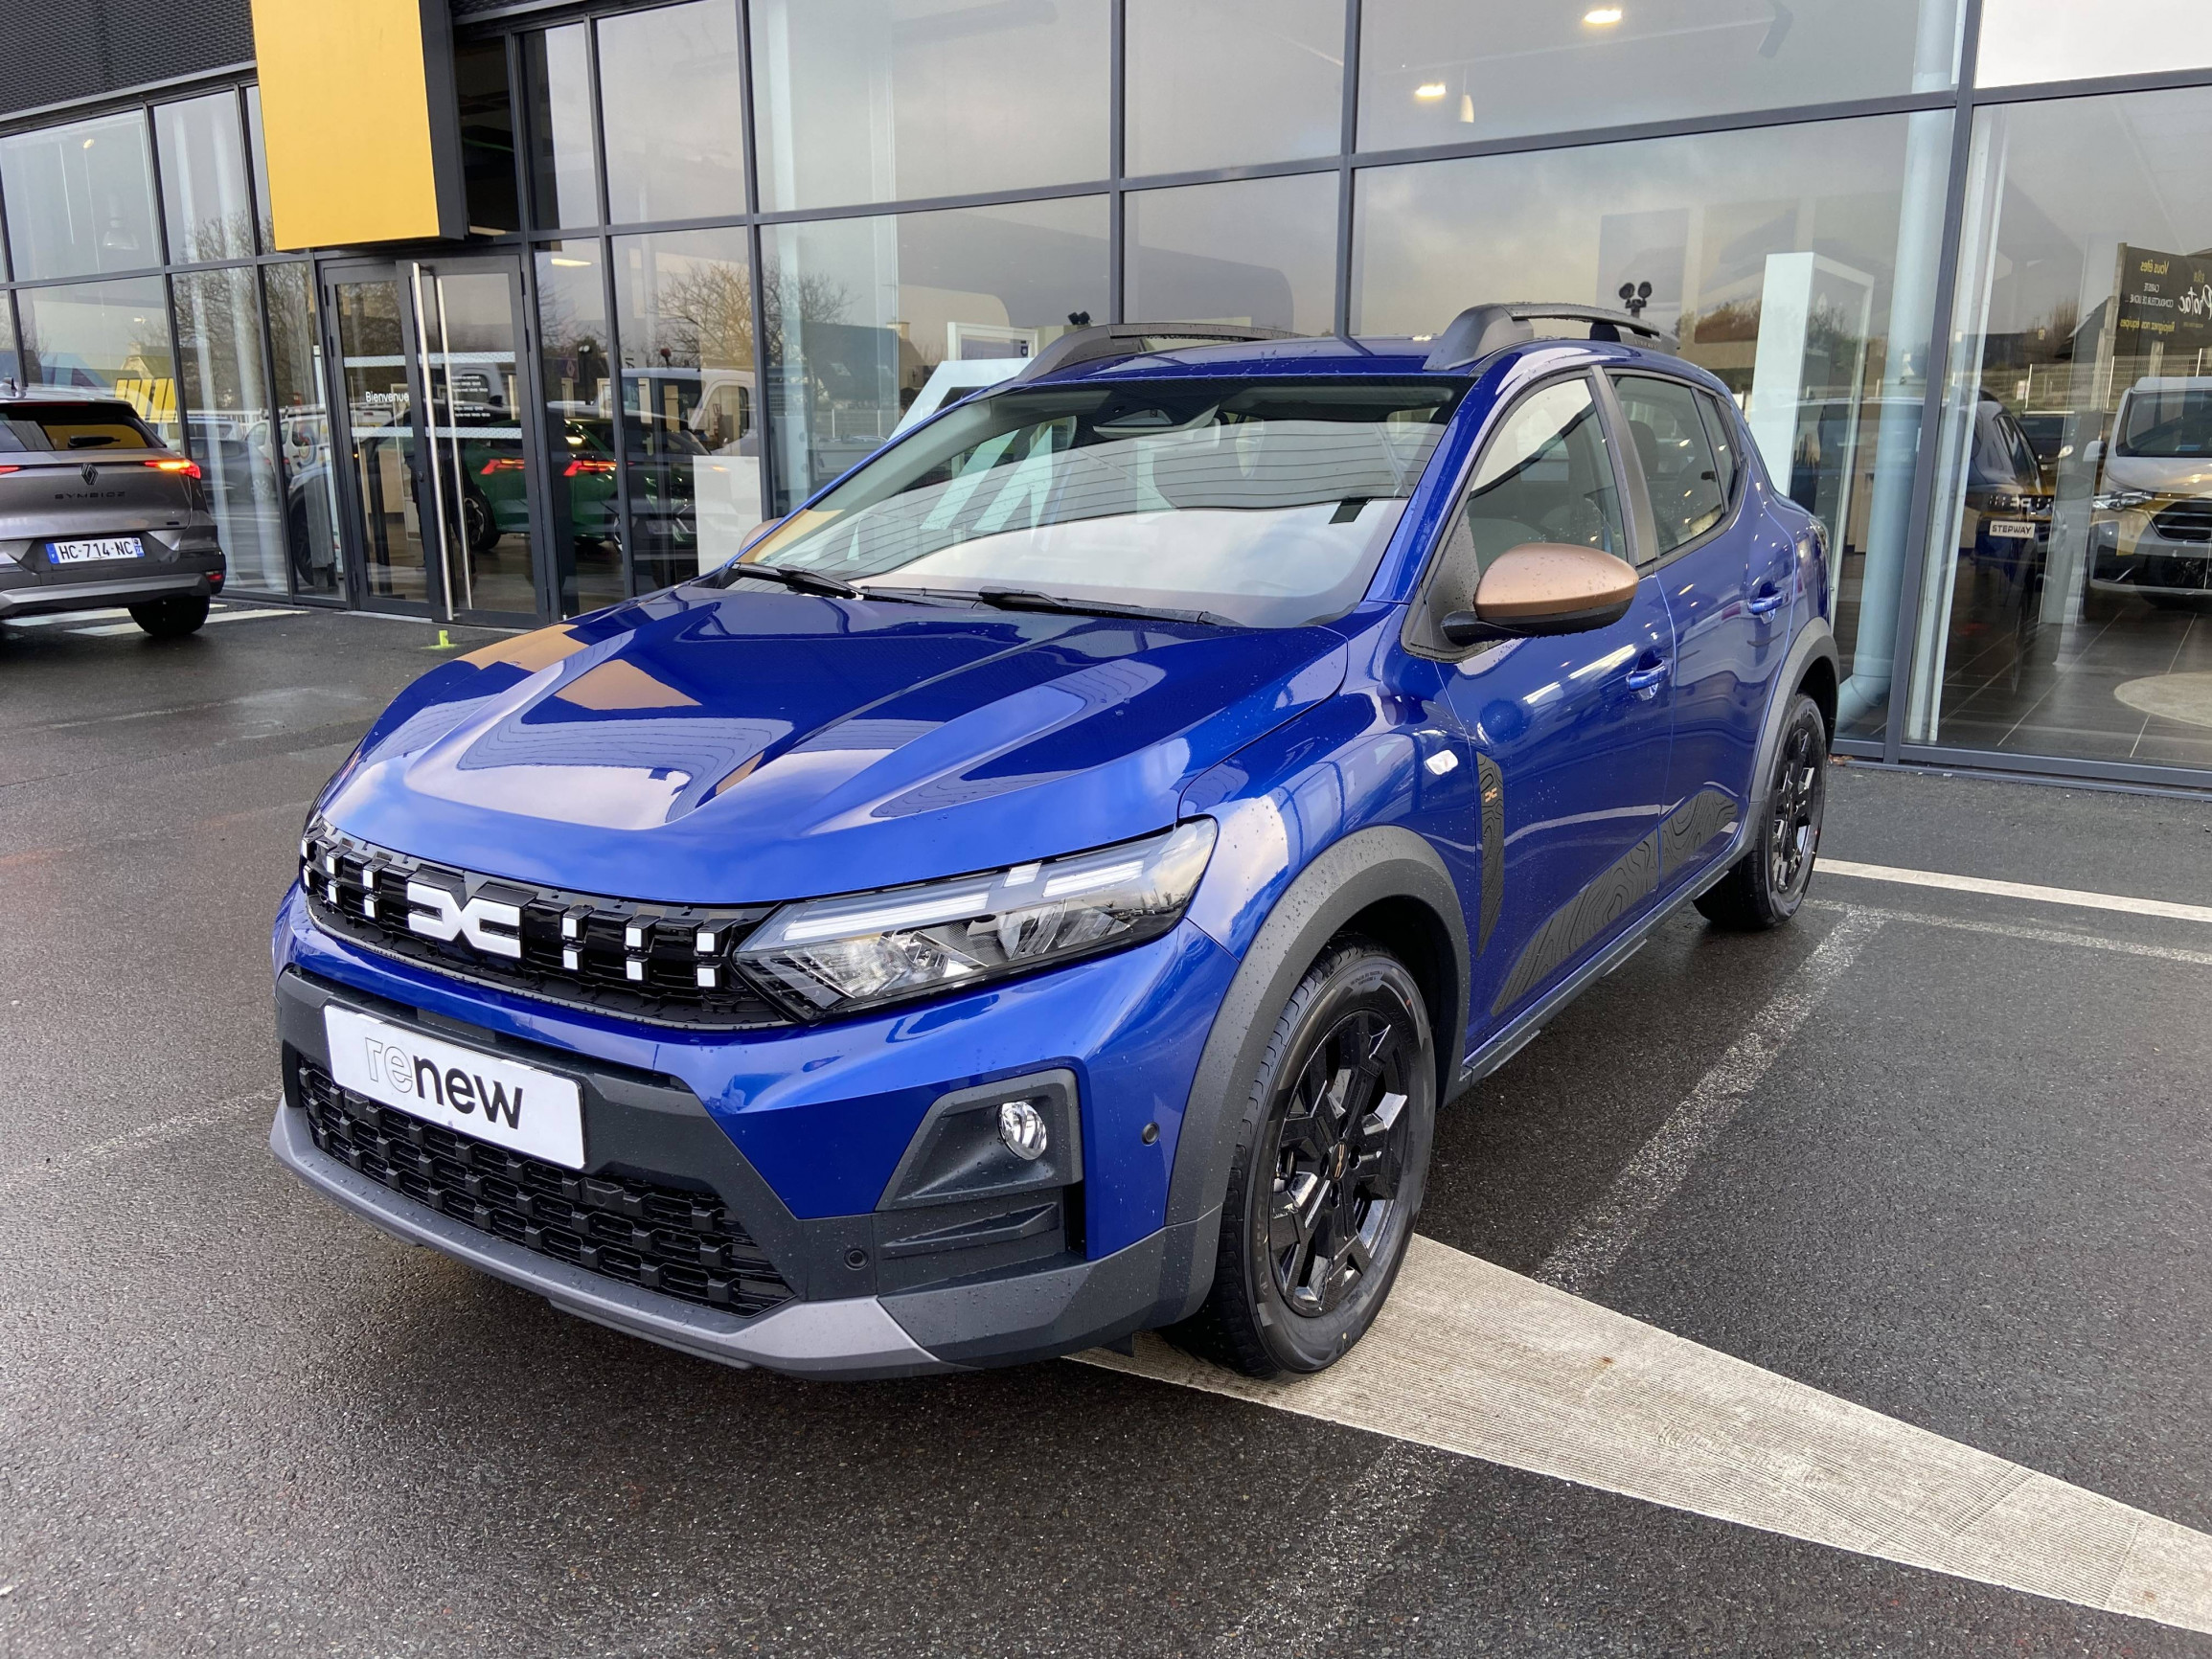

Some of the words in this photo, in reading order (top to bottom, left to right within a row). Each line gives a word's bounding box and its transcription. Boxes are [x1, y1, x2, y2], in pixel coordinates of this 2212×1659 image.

[365, 391, 410, 402] Bienvenue
[1992, 524, 2032, 534] STEPWAY
[58, 541, 133, 560] HC-714-NC
[365, 1037, 523, 1130] renew
